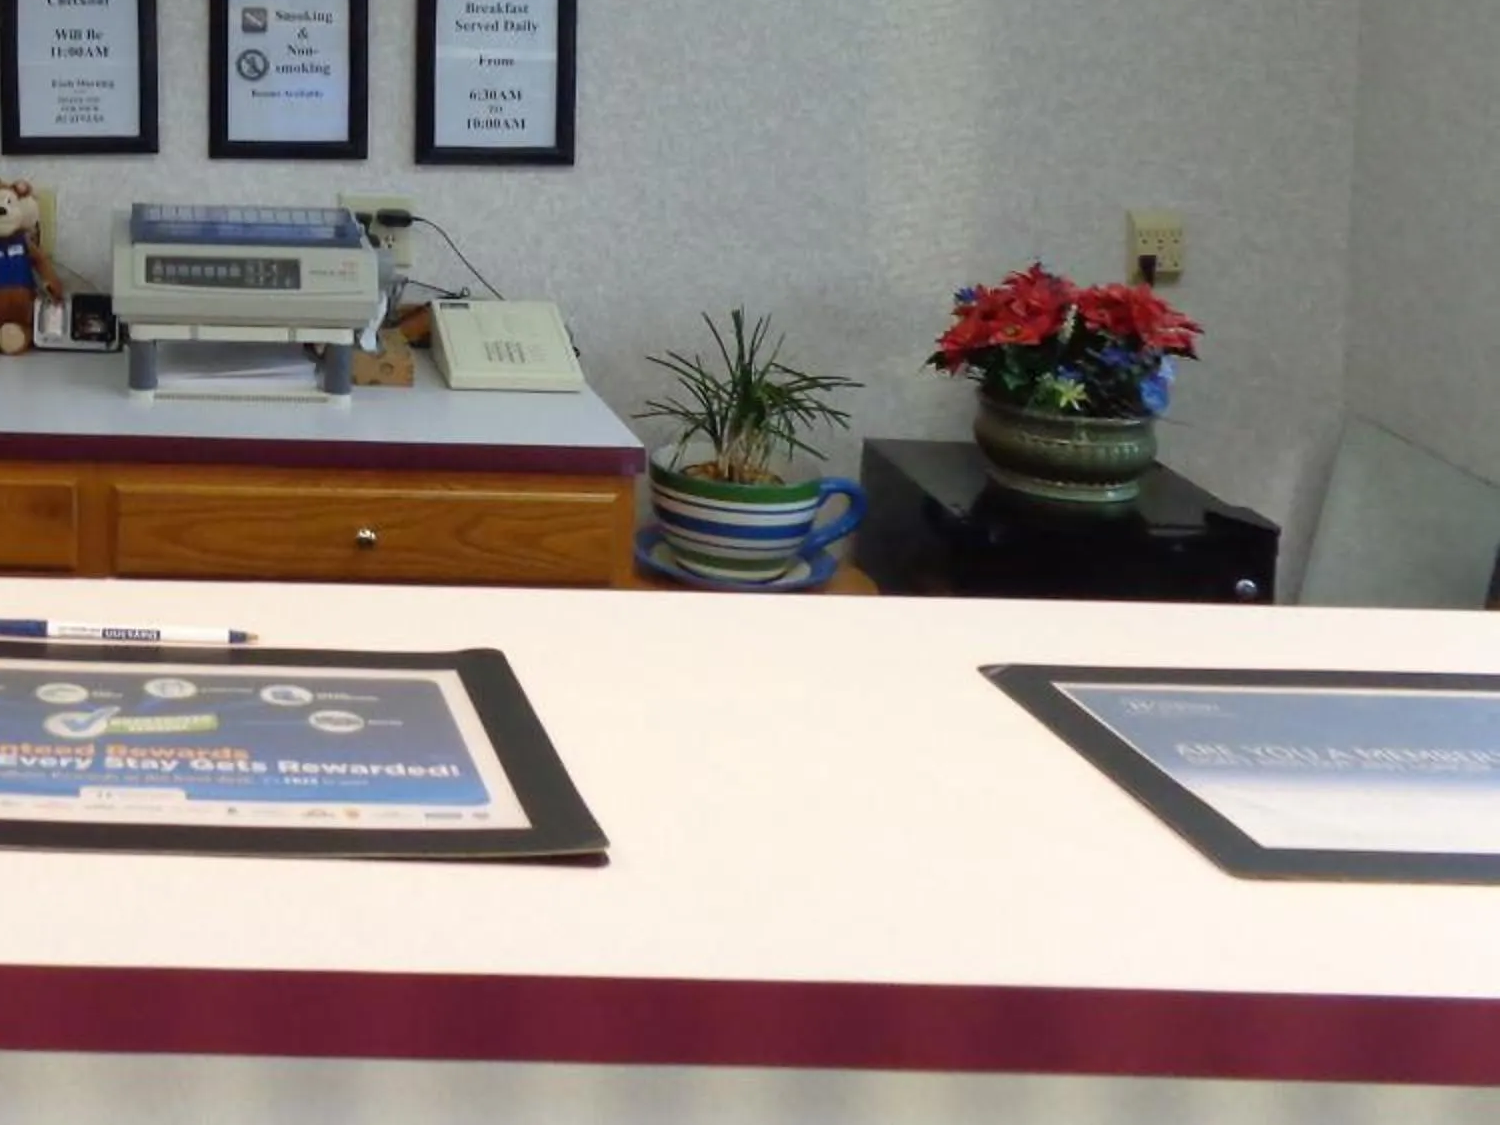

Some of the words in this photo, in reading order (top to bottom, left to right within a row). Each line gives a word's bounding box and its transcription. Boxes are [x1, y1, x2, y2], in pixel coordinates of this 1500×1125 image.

[465, 2, 529, 14] Breakfast
[275, 10, 333, 24] Smoking
[455, 19, 499, 32] Served
[503, 19, 539, 33] Daily
[54, 28, 82, 40] Will
[85, 28, 103, 40] Be
[287, 44, 319, 56] Non-
[479, 54, 515, 66] From
[275, 62, 331, 75] smoking
[105, 743, 251, 761] Rewards
[103, 755, 181, 775] Stay
[189, 758, 268, 775] Gets
[277, 760, 461, 779] Rewarded!
